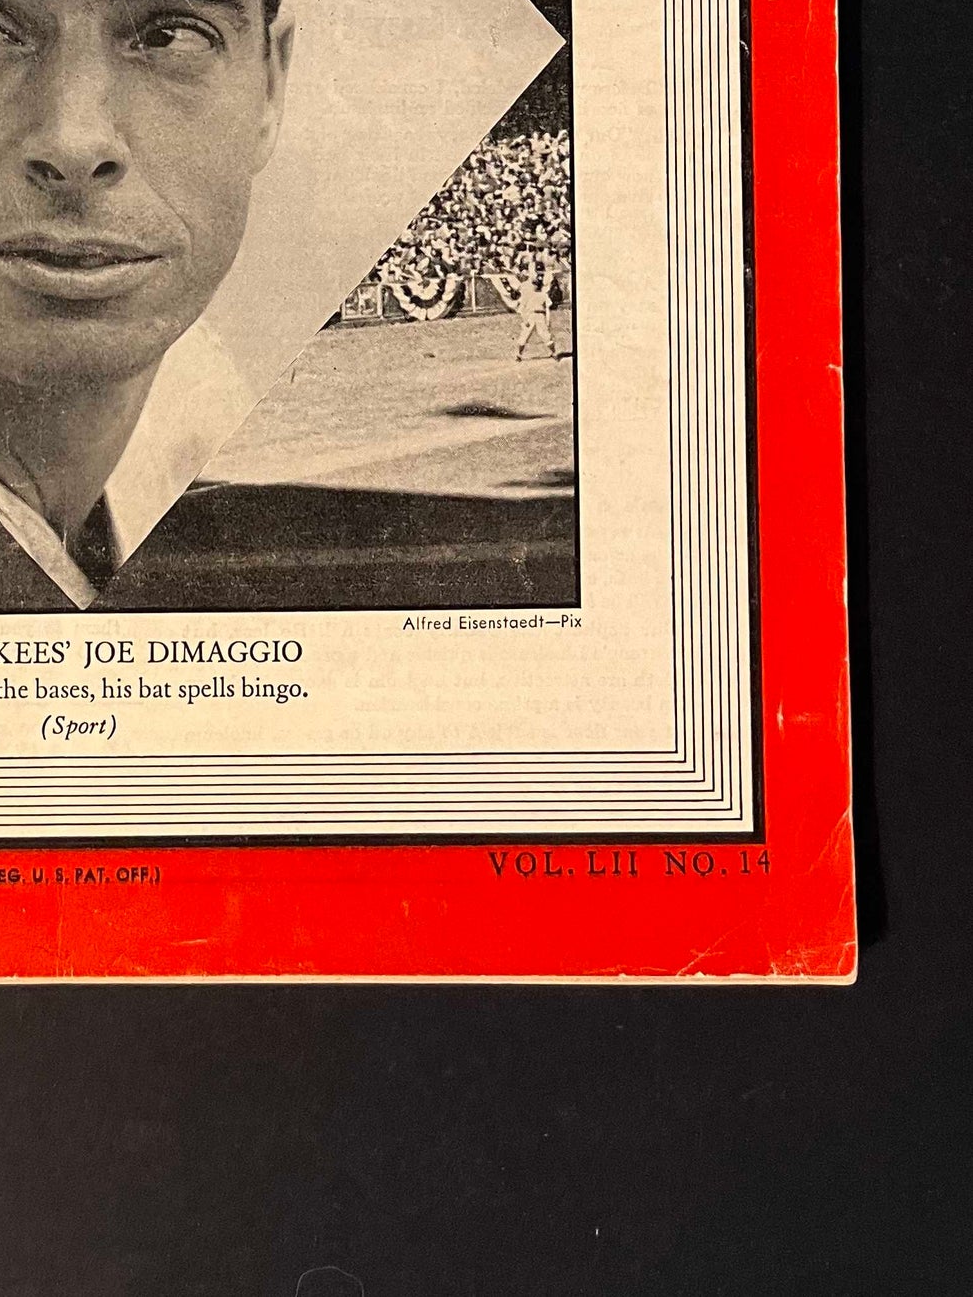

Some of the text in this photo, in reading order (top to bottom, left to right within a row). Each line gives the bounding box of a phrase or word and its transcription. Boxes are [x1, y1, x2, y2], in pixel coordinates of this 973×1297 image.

[402, 615, 452, 631] Alfred
[83, 640, 135, 669] JOE
[147, 640, 303, 664] DIMAGGIO
[35, 677, 95, 703] bases,
[102, 677, 132, 699] his
[139, 676, 171, 699] bat
[178, 676, 235, 705] spells
[242, 676, 308, 704] bingo.
[41, 714, 117, 741] (Sport)
[74, 867, 110, 885] PAT.
[115, 866, 161, 886] OFF.)
[487, 849, 771, 878] VOL. LII NO. 14
